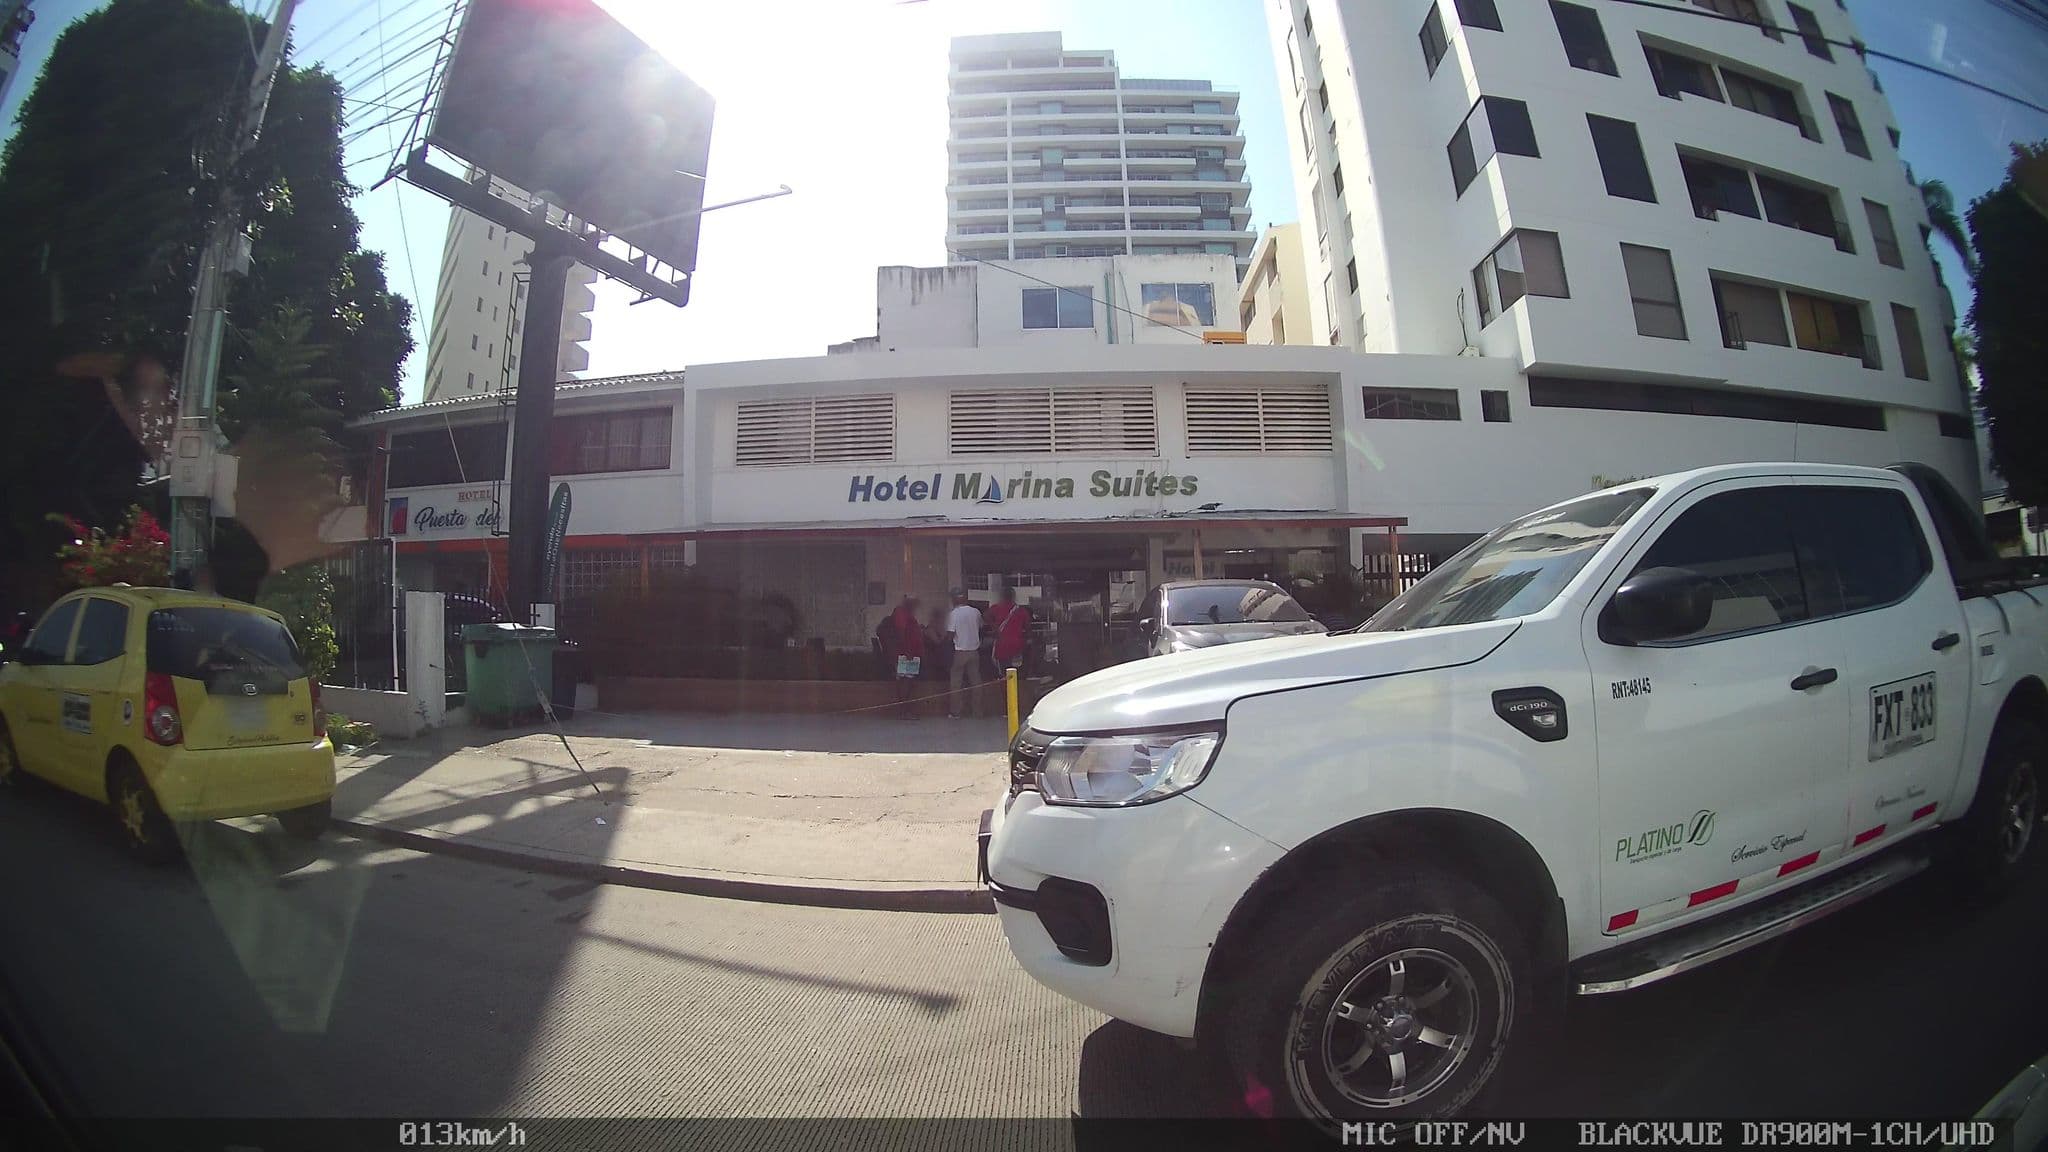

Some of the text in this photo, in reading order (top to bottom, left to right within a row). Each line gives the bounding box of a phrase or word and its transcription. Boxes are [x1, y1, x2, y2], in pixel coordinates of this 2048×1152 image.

[457, 489, 493, 502] HOTEL
[848, 473, 942, 503] Hotel
[1089, 469, 1199, 498] Suites
[1611, 677, 1652, 700] RNT:48145
[1530, 701, 1549, 709] 190
[1873, 681, 1934, 744] FXT 833
[1615, 823, 1684, 862] PLATINO
